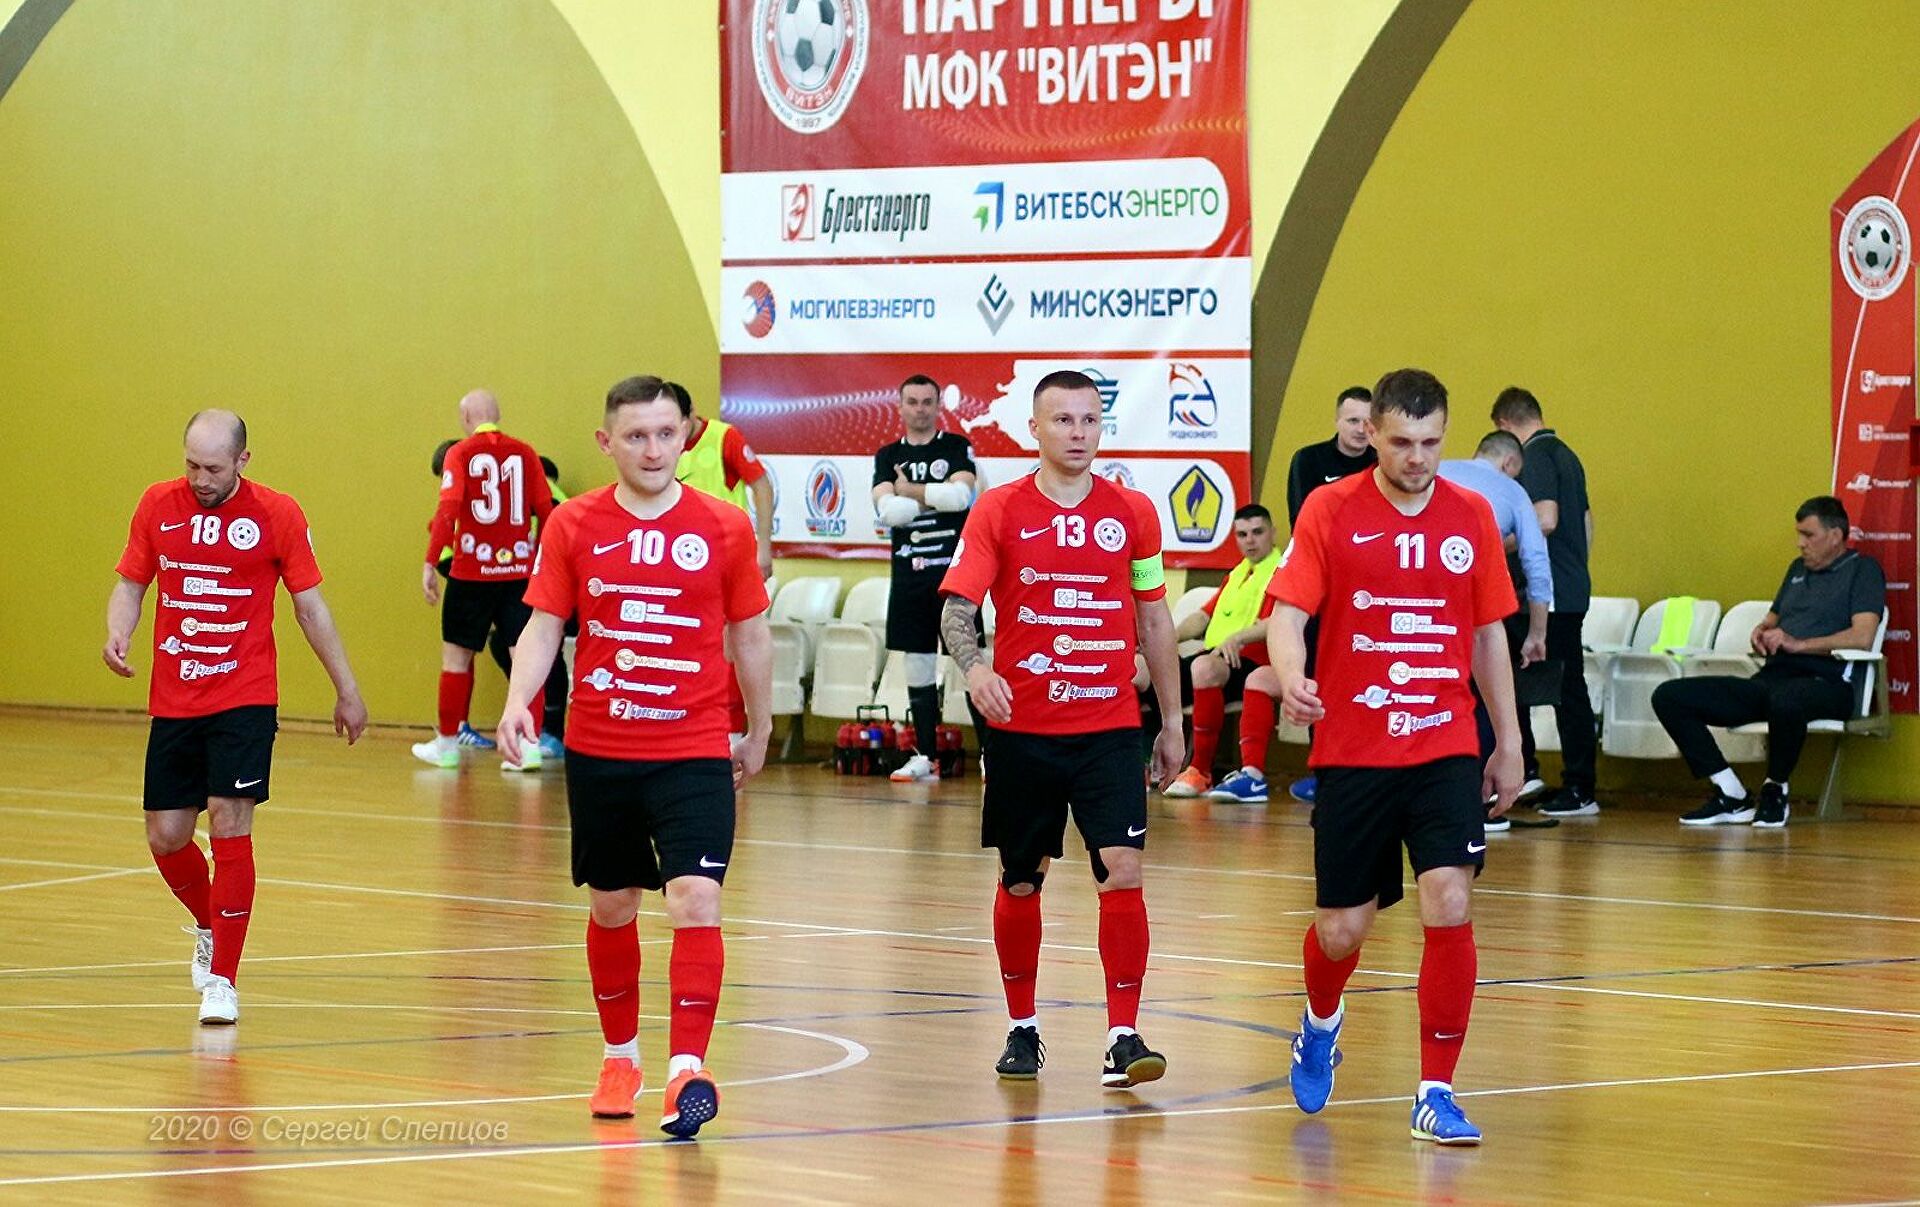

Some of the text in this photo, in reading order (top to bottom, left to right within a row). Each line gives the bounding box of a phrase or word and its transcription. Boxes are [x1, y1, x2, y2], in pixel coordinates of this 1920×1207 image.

[903, 49, 1008, 110] МФК
[1017, 38, 1213, 106] "ВИТЭН"
[821, 187, 931, 243] Брестэнерго
[1015, 186, 1220, 221] ВИТЕБСКЭНЕРГО
[790, 298, 936, 320] МОГИЛЕВЭНЕРГО
[1030, 287, 1218, 319] МИНСКЭНЕРГО
[909, 461, 929, 481] 19
[469, 453, 524, 525] 31
[190, 514, 222, 545] 18
[627, 528, 666, 565] 10
[1051, 514, 1086, 548] 13
[1394, 532, 1425, 569] 11
